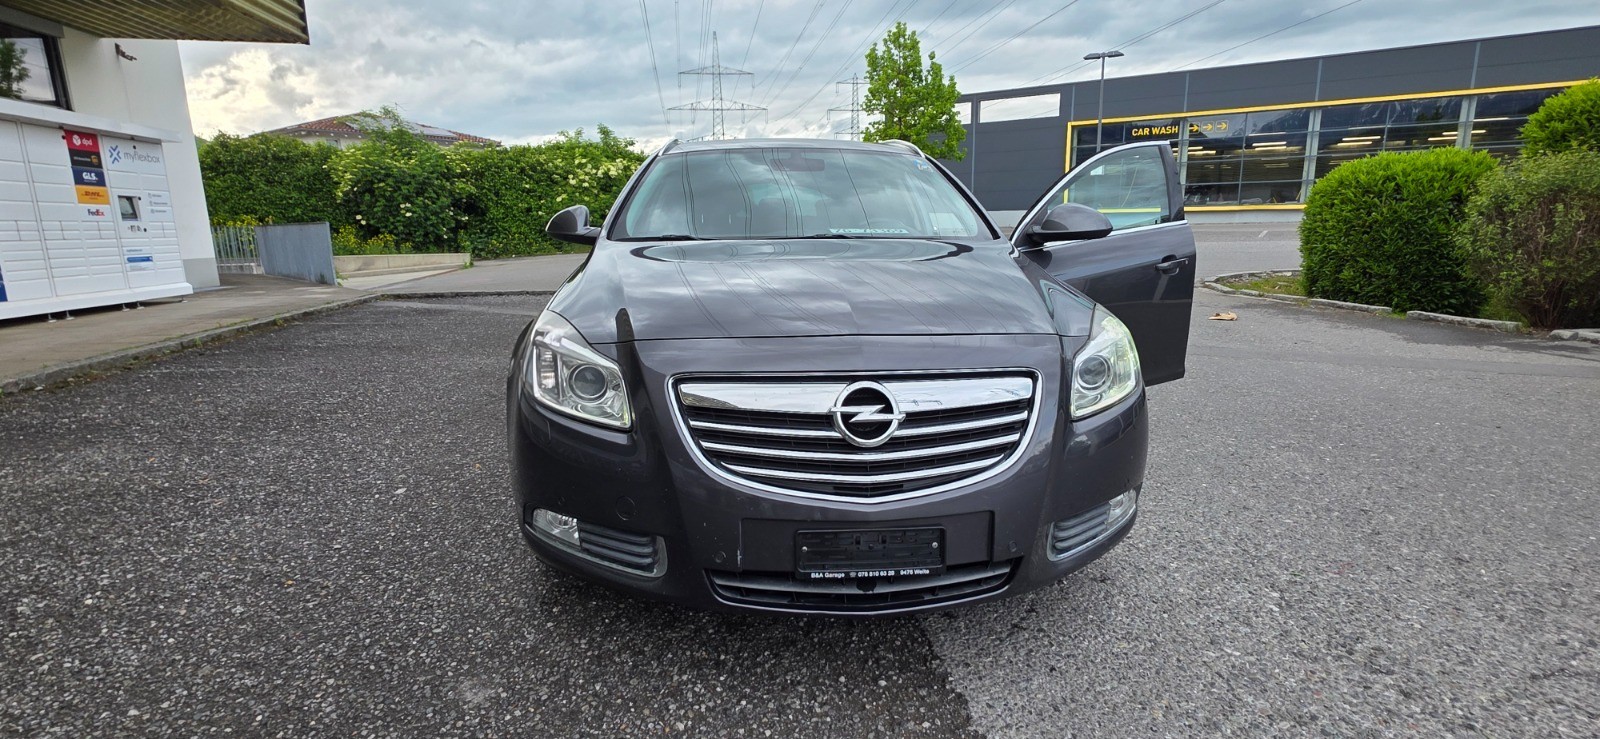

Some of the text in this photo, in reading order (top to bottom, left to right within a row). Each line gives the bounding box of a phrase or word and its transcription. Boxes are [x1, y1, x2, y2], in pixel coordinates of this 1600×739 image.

[1132, 126, 1179, 136] CAR WASH
[123, 151, 160, 163] myflexbox
[87, 208, 105, 216] FedEx
